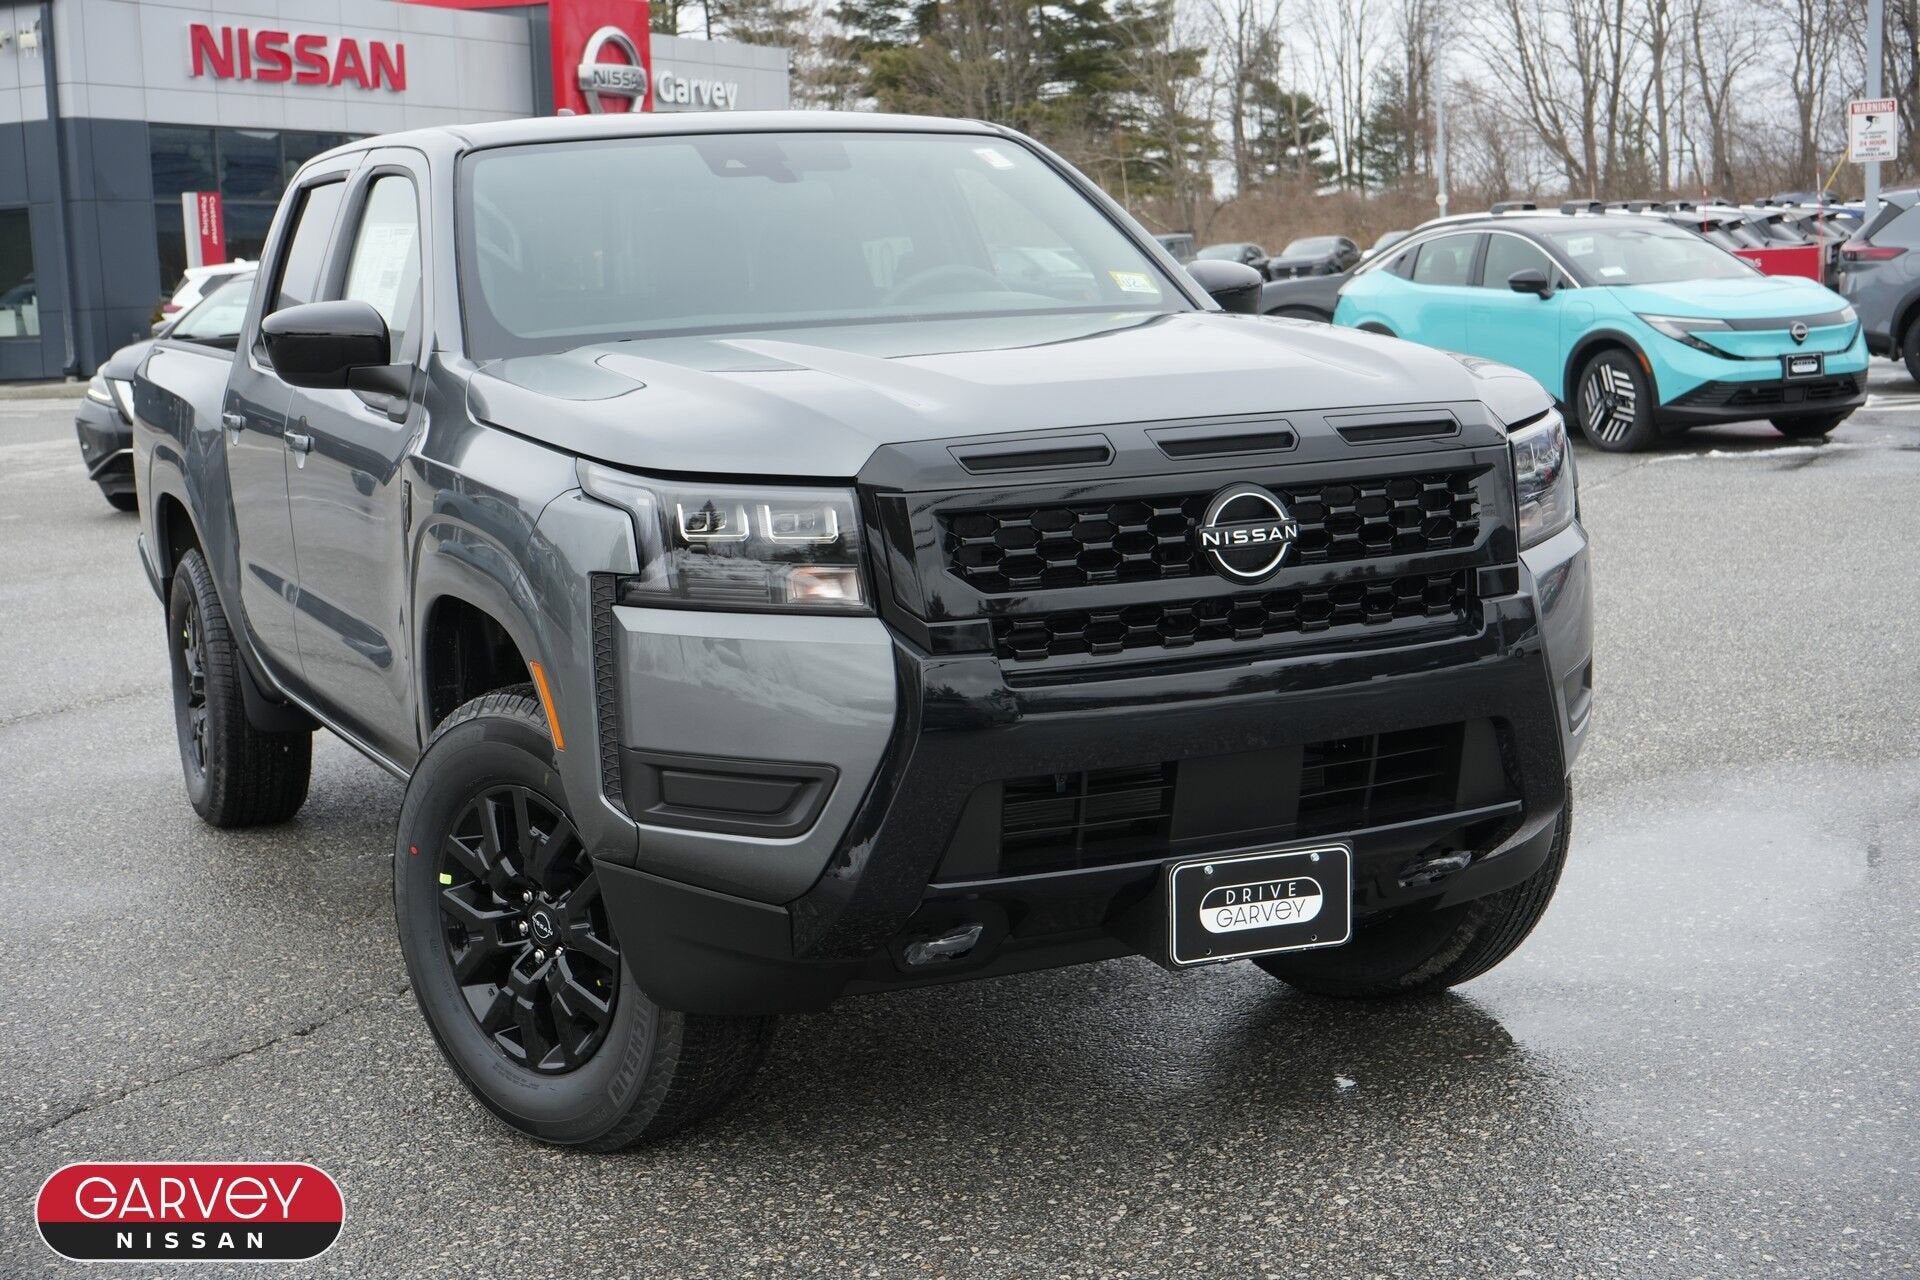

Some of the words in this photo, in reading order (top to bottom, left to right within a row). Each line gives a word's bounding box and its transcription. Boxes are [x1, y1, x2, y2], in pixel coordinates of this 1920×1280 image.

[189, 23, 407, 92] NISSAN
[657, 70, 739, 111] Garvey
[1853, 101, 1894, 113] WARNING
[209, 195, 219, 246] Customer
[1202, 524, 1297, 546] NISSAN
[1226, 881, 1298, 906] DRIVE
